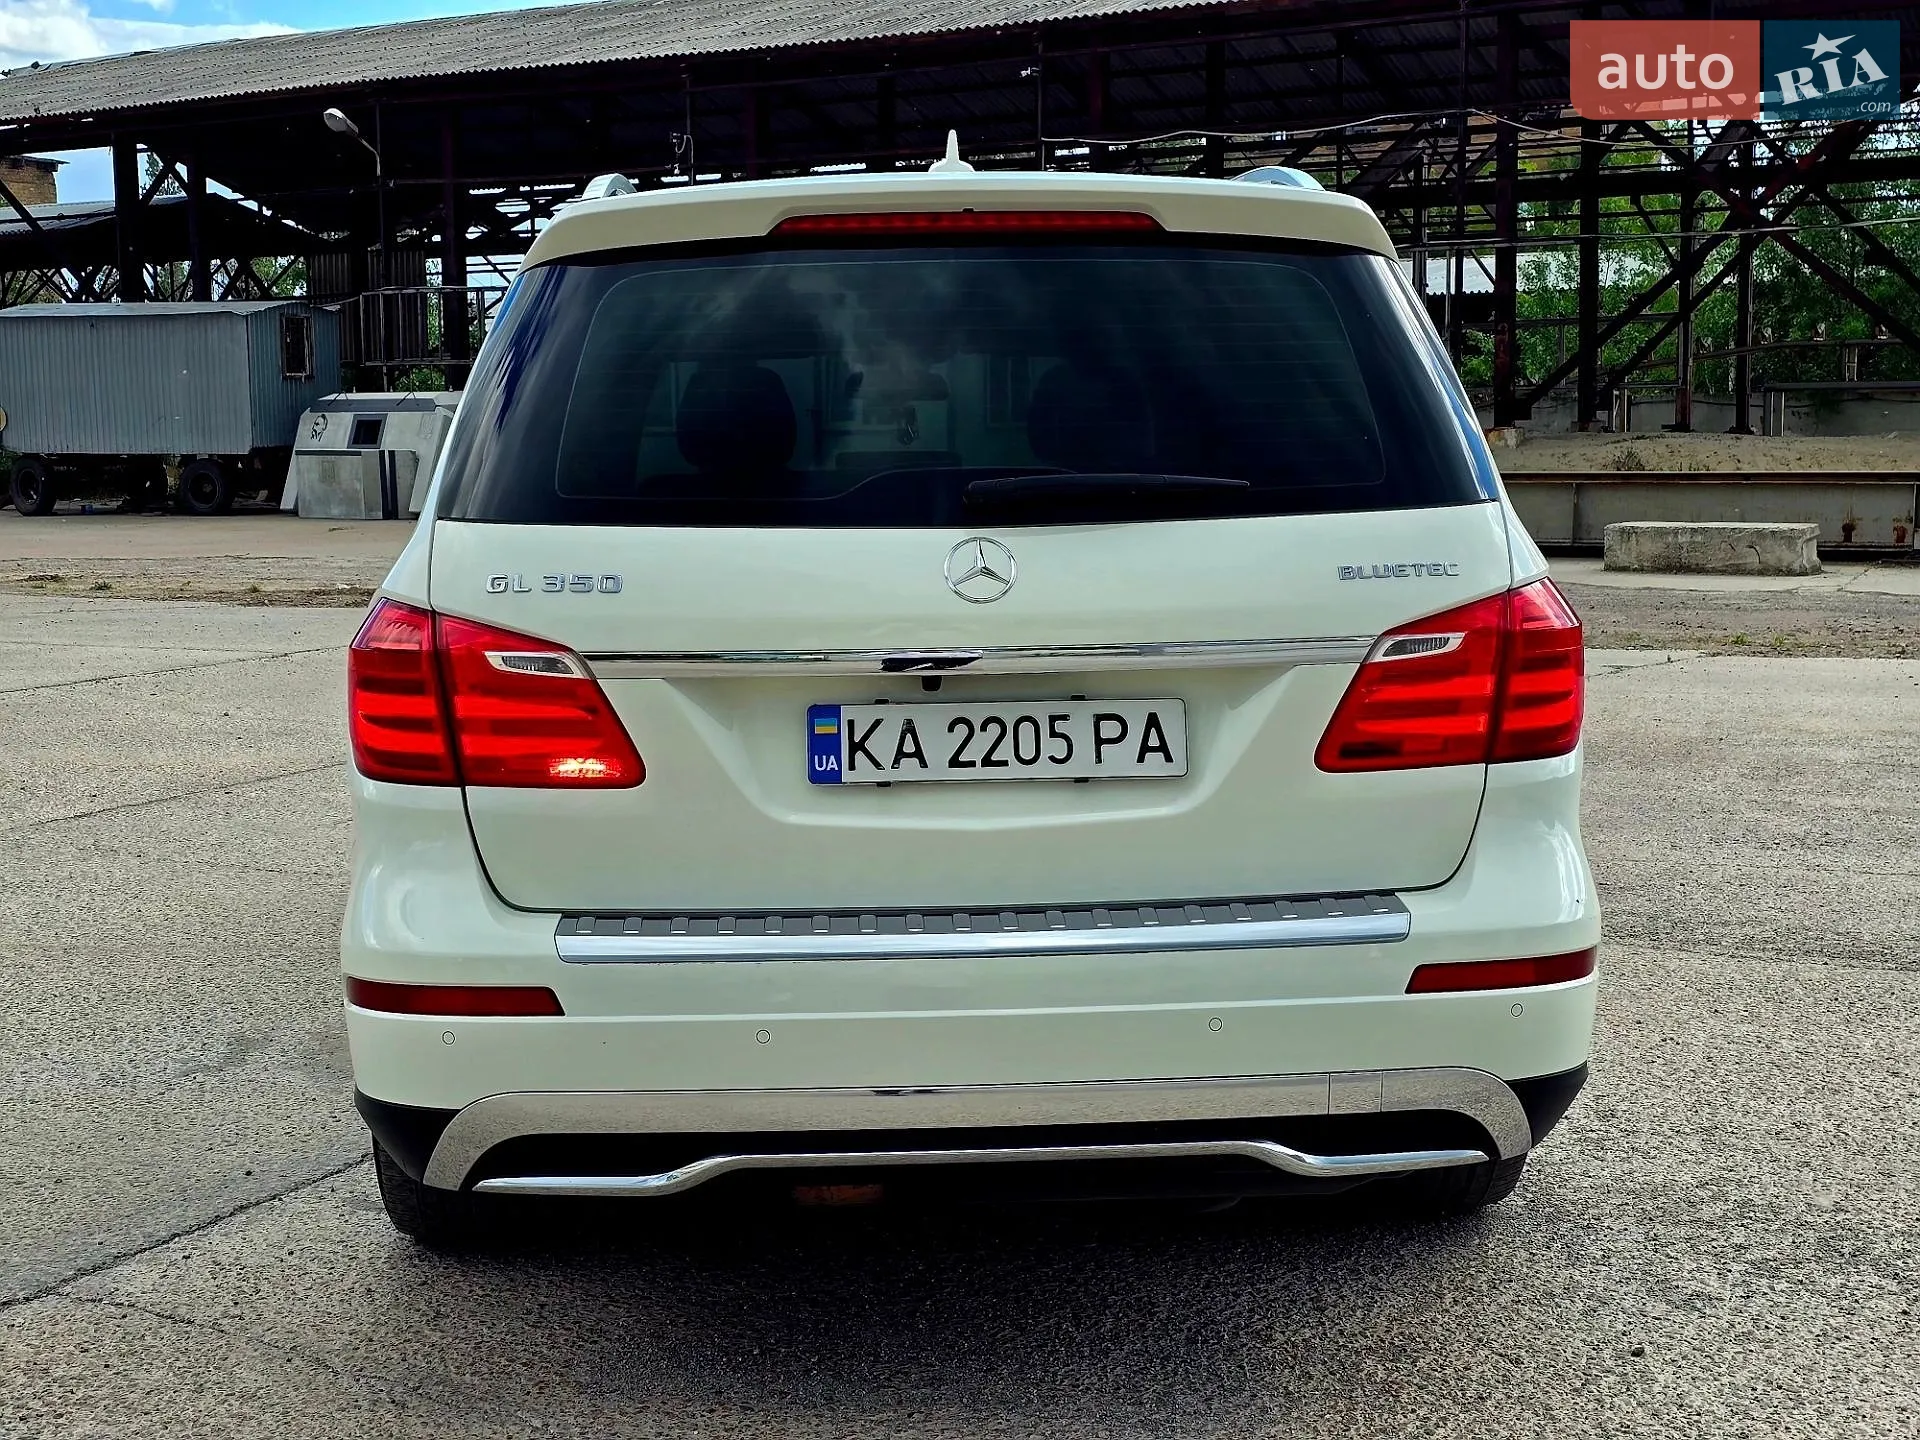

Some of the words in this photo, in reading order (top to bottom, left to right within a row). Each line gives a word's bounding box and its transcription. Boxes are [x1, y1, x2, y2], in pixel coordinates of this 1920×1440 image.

[1338, 562, 1460, 580] BLUETEC
[486, 574, 532, 593] GL
[541, 574, 623, 593] 350
[847, 718, 929, 771] KA
[946, 715, 1075, 768] 2205
[1093, 712, 1174, 764] PA
[814, 754, 839, 771] UA
